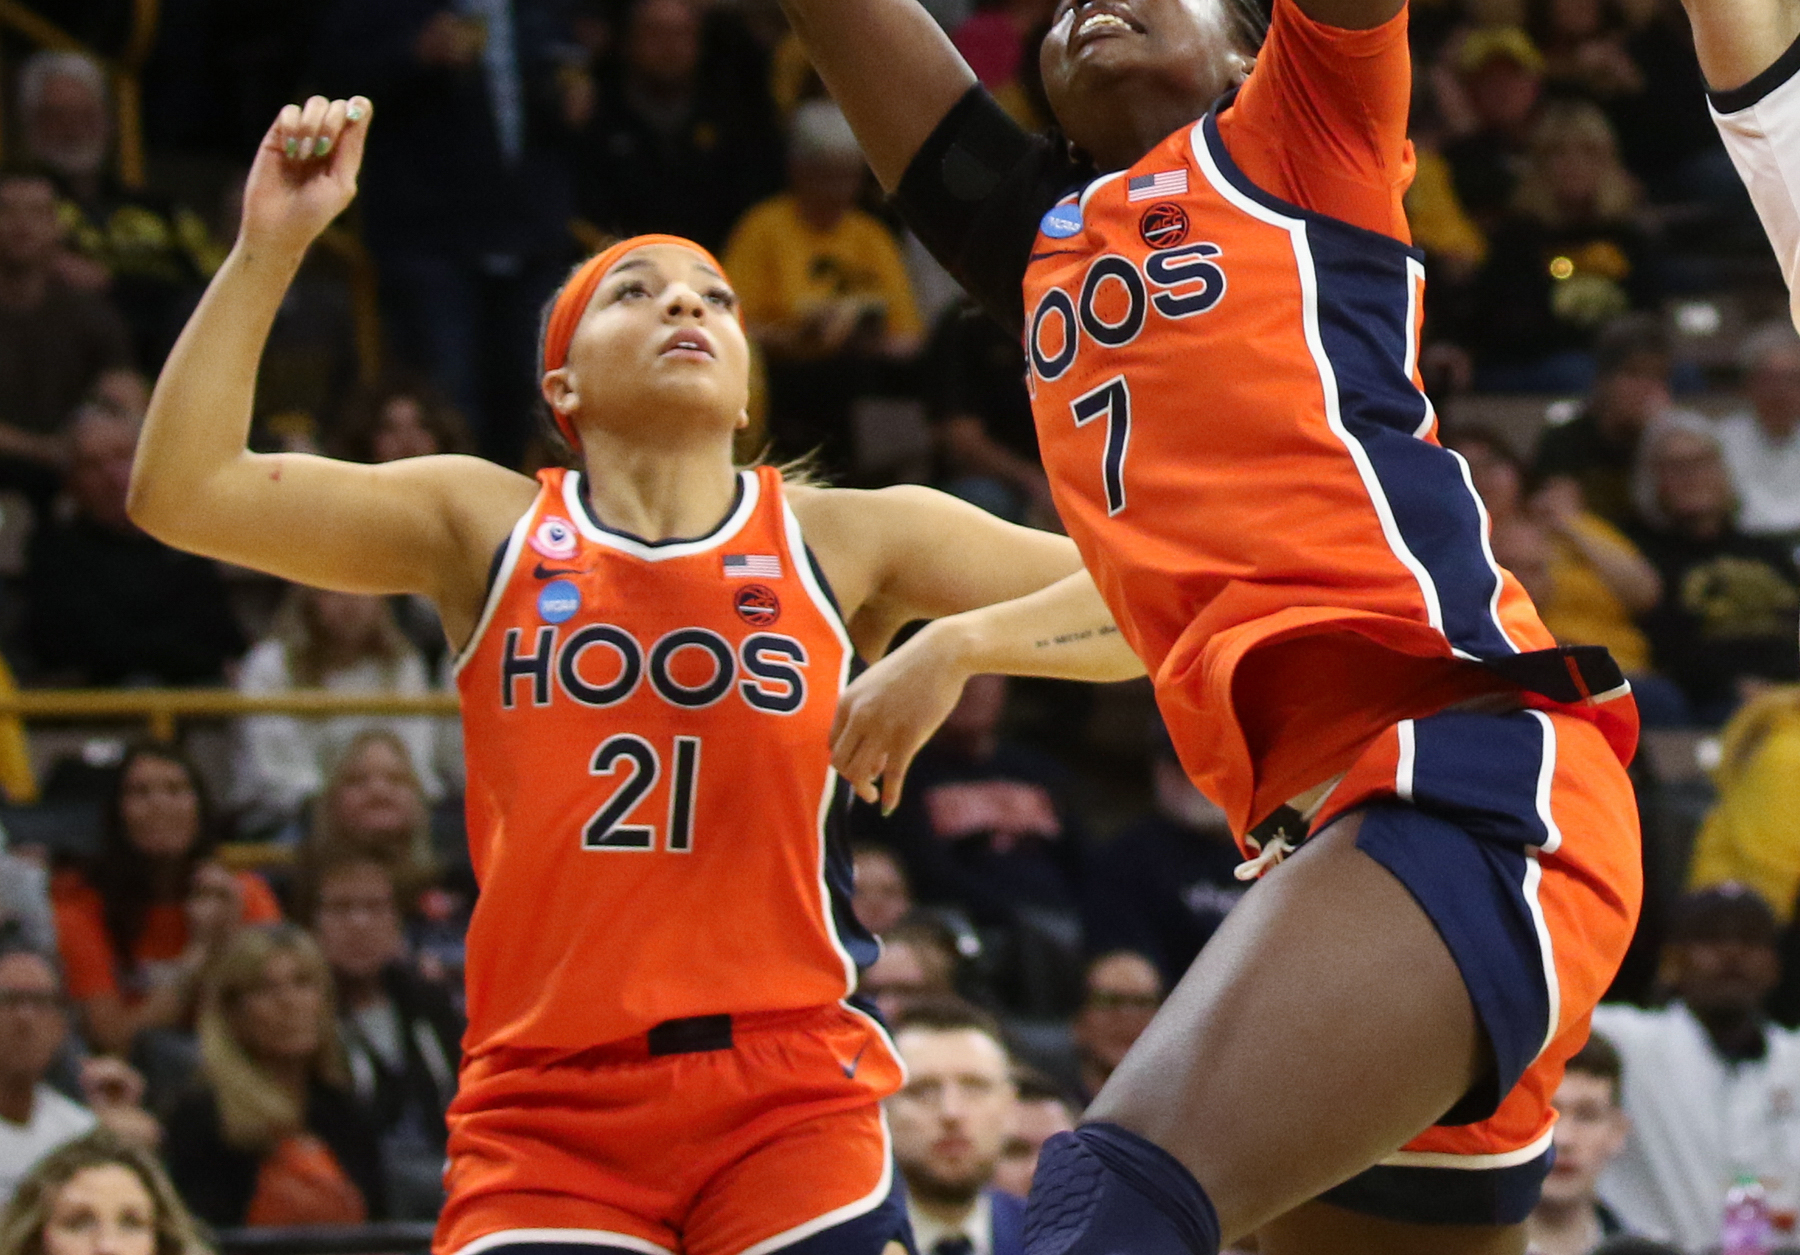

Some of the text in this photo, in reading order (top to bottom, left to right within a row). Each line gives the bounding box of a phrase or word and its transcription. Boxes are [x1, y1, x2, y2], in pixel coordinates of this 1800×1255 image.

[1070, 373, 1131, 517] 7
[502, 623, 810, 715] HOOS
[581, 733, 701, 854] 21
